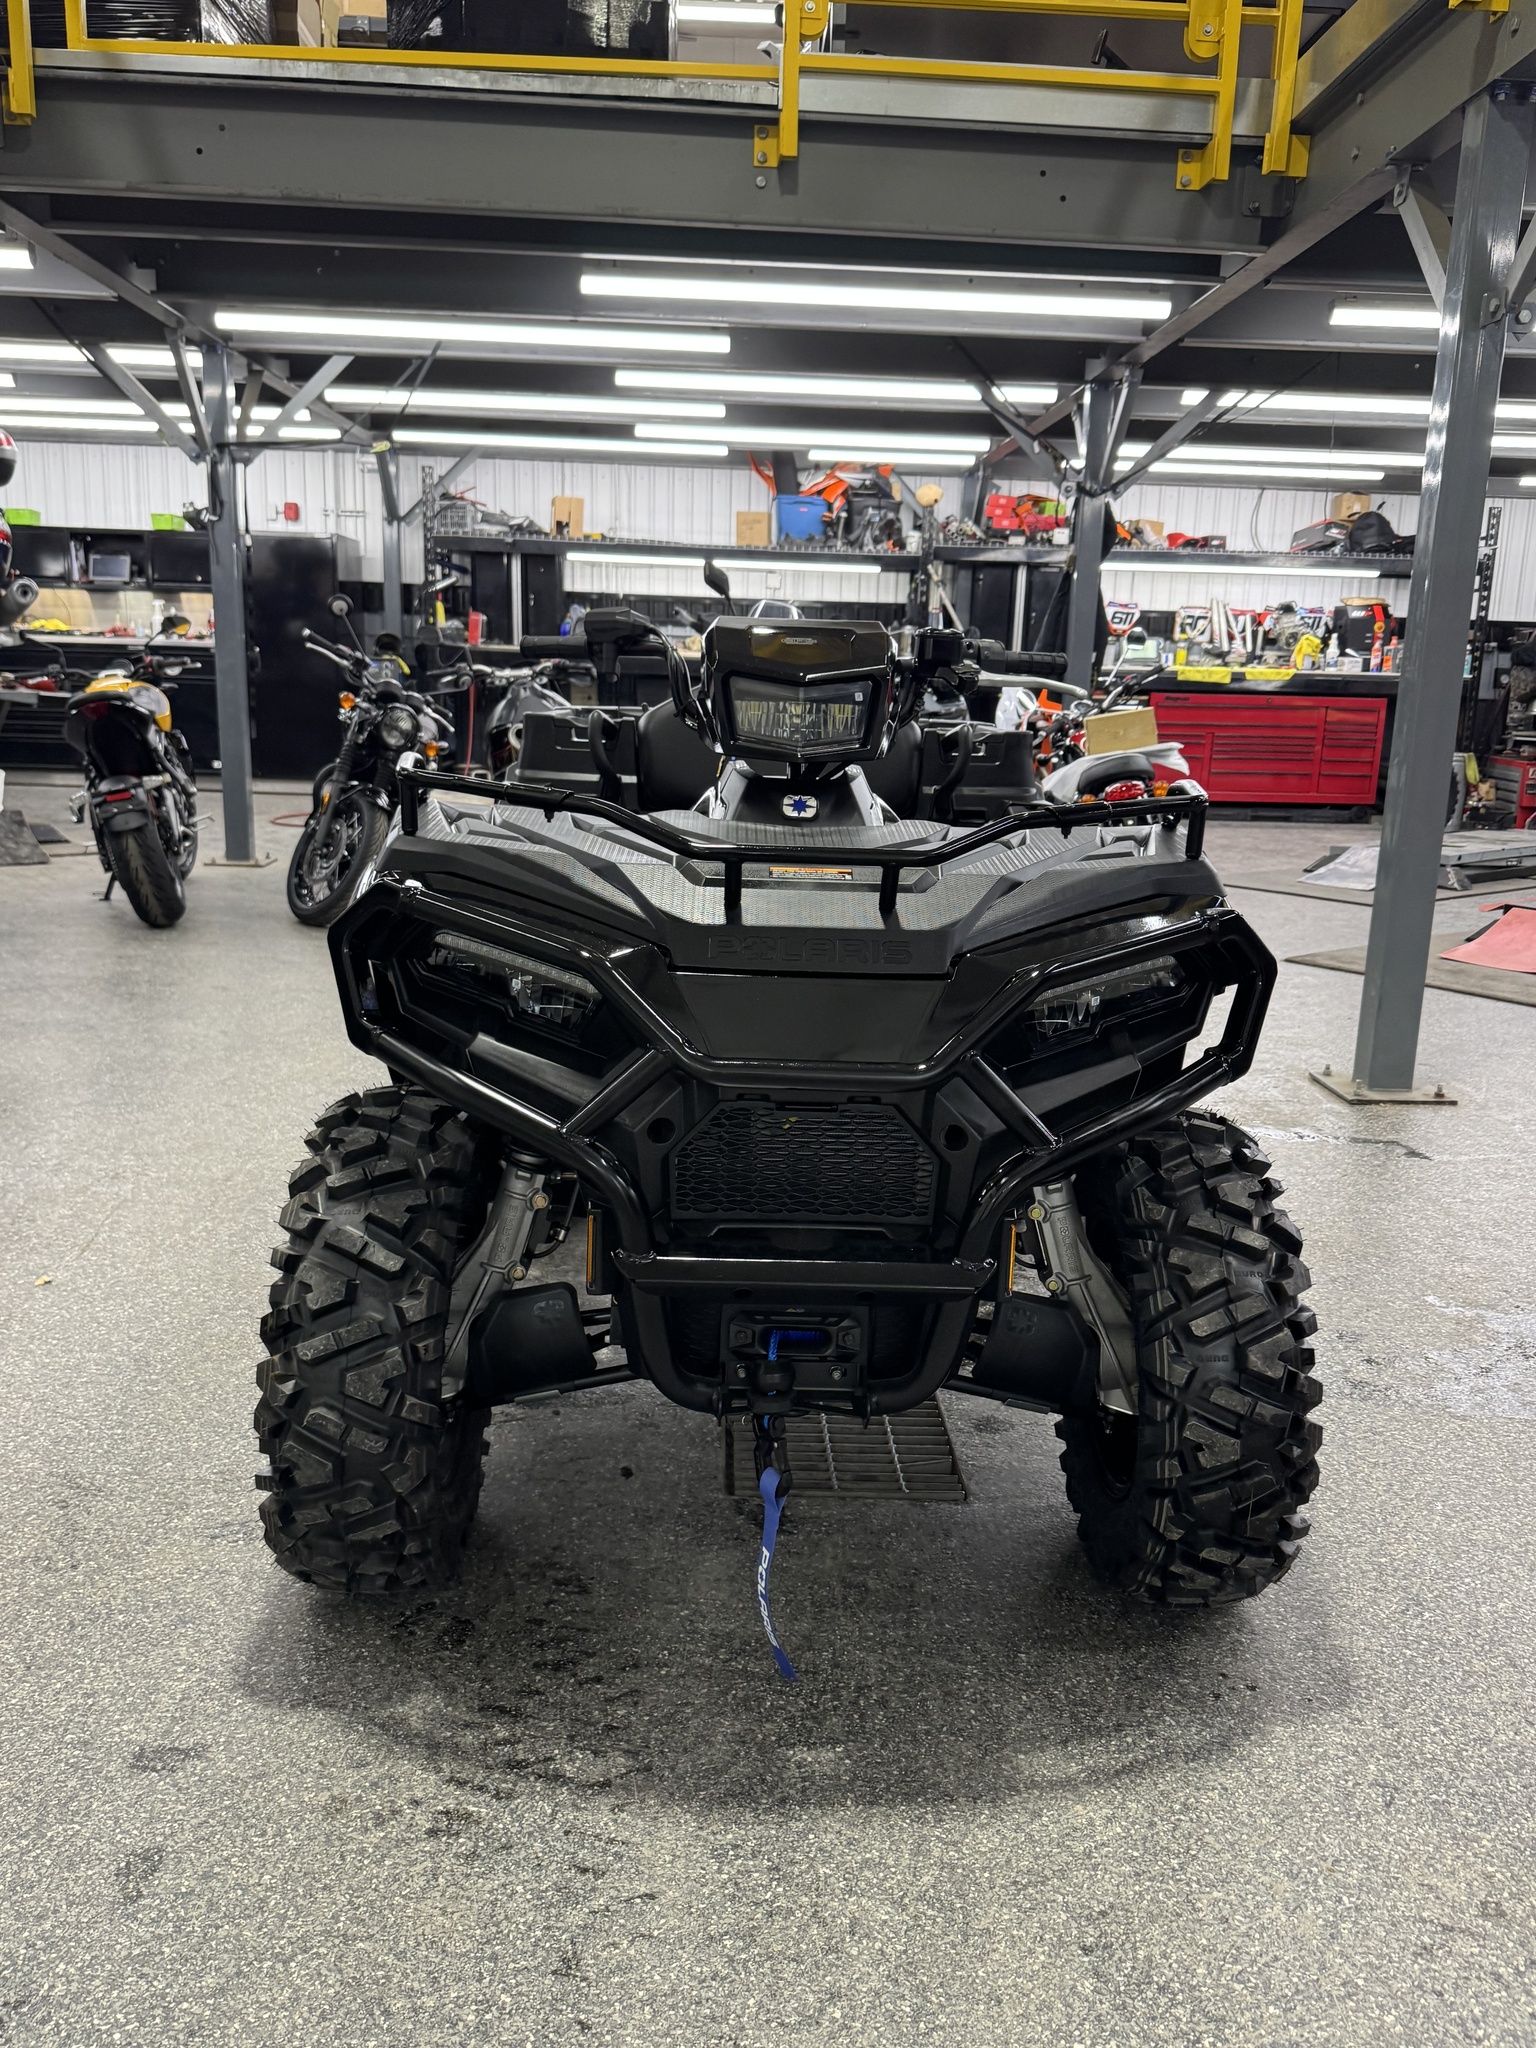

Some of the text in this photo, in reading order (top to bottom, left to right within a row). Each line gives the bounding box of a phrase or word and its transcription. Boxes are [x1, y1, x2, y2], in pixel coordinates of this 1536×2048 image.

[1111, 611, 1135, 626] 611
[708, 934, 913, 965] POLARIS
[494, 1204, 519, 1262] POLARIS
[1057, 1216, 1079, 1275] POLARIS
[757, 1545, 780, 1649] POLARIS
